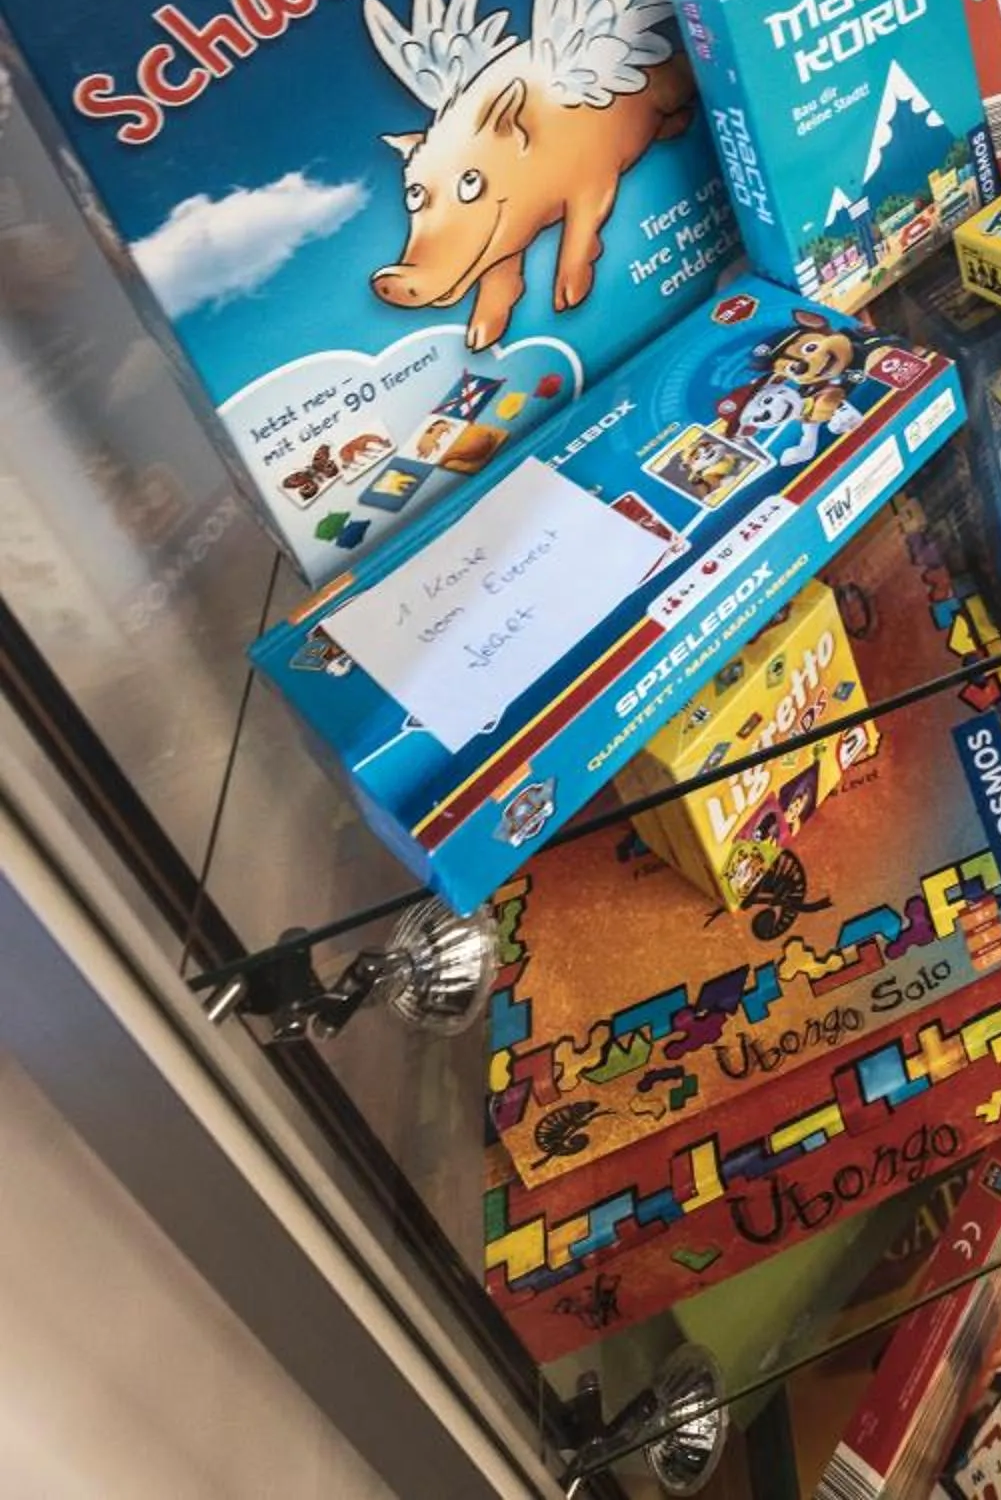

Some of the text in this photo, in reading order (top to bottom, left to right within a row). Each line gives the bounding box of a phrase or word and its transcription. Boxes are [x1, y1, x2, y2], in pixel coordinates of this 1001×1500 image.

[711, 109, 751, 209] KORO
[728, 107, 775, 227] MACHI
[629, 247, 673, 286] ihre
[640, 197, 691, 241] Tiere
[250, 387, 339, 444] Jetzt neu
[262, 346, 440, 468] mit über 90 Tieren!
[548, 400, 639, 471] LEBOX
[614, 559, 773, 718] SPIELEBOX
[586, 684, 674, 772] QUARTETT
[715, 956, 953, 1080] Ubongo Solo
[730, 1118, 962, 1246] Ubongo
